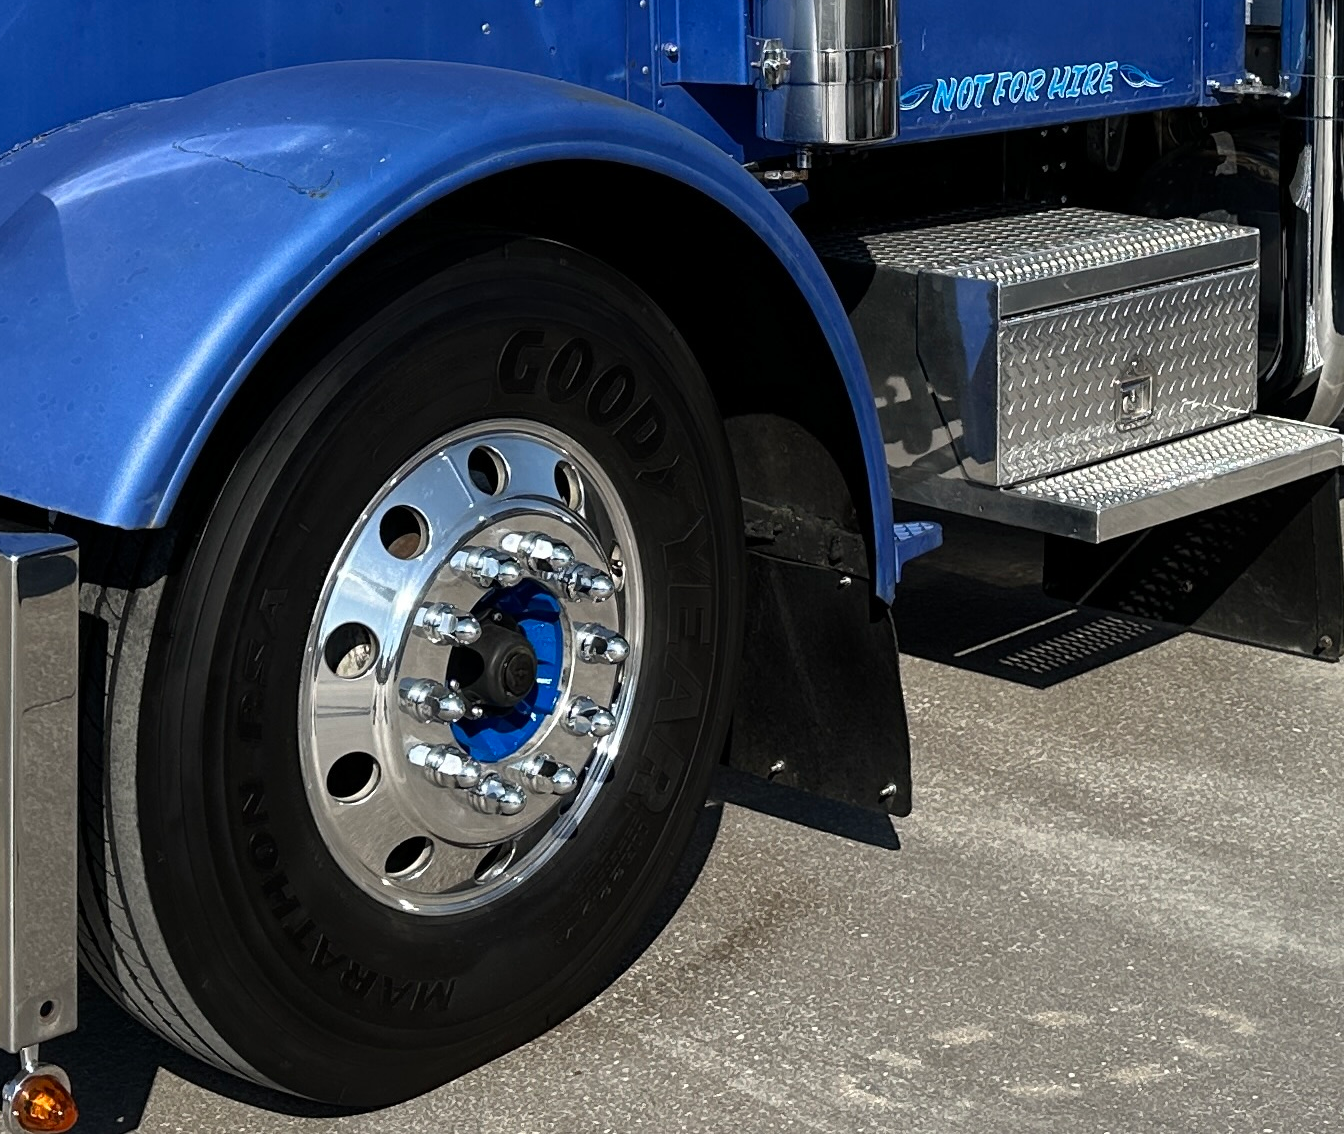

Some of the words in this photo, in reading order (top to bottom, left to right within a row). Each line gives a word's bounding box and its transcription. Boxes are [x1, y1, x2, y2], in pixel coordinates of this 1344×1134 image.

[931, 72, 994, 114] NOT
[993, 68, 1046, 106] FOR
[1047, 60, 1119, 99] HIRE
[497, 329, 712, 815] GOODYEAR
[238, 777, 456, 1015] MARATHON
